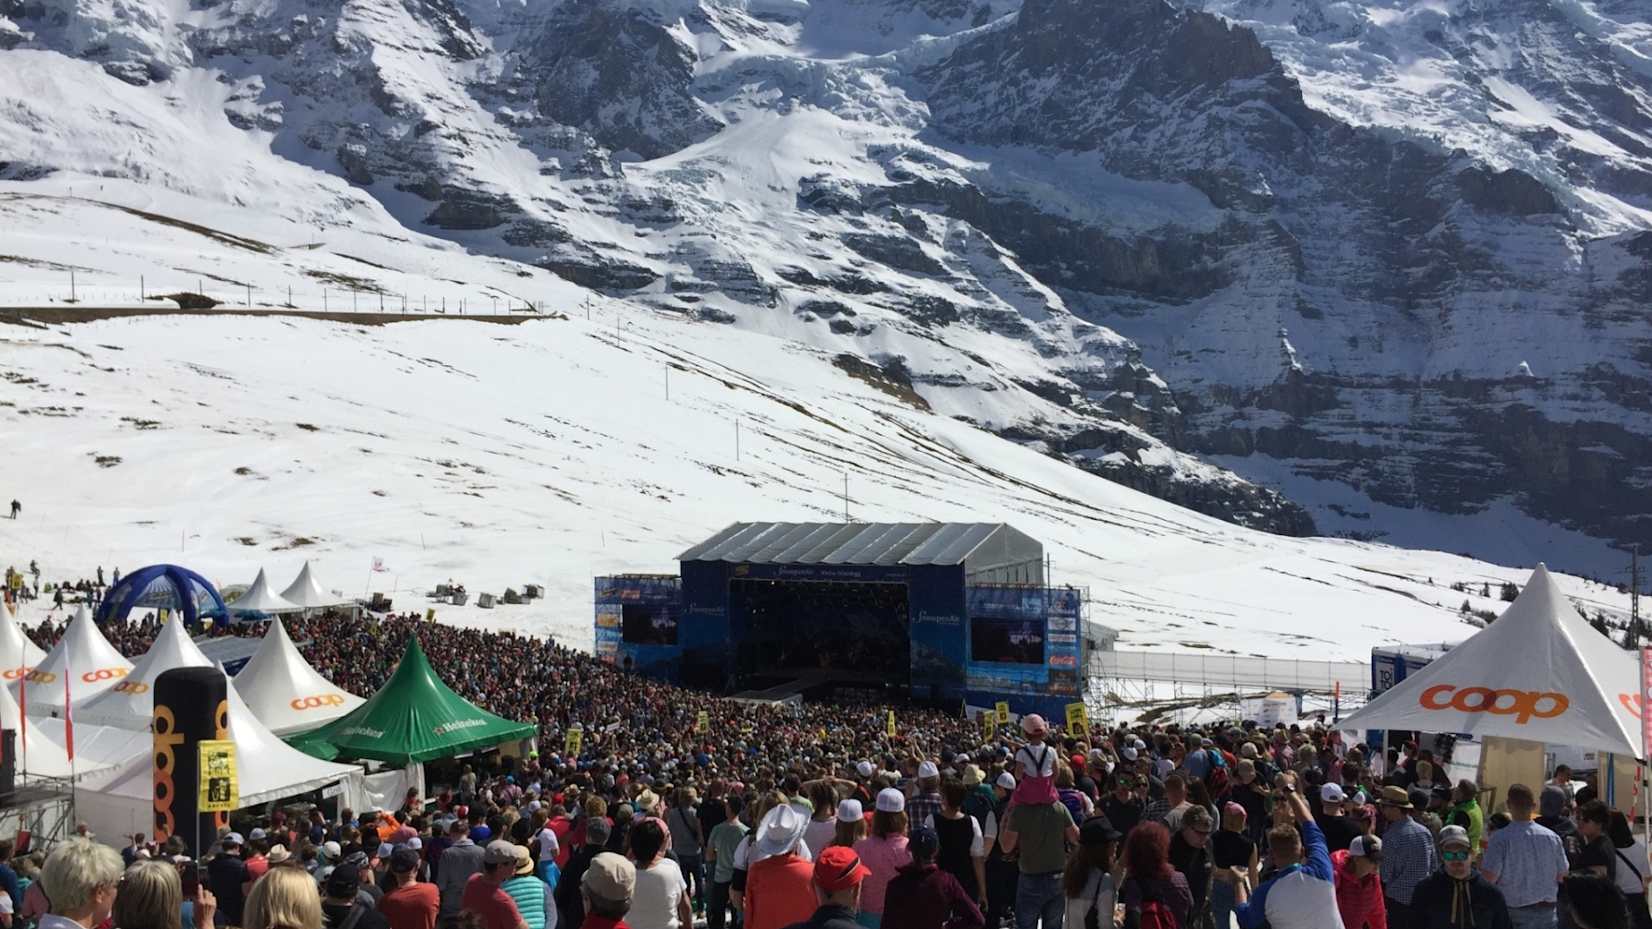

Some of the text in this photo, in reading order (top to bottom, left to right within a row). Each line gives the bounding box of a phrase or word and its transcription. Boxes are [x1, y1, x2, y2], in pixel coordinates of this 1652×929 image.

[290, 694, 345, 711] coop
[1418, 684, 1570, 725] coop
[442, 718, 488, 732] Heineken
[153, 704, 184, 844] coop
